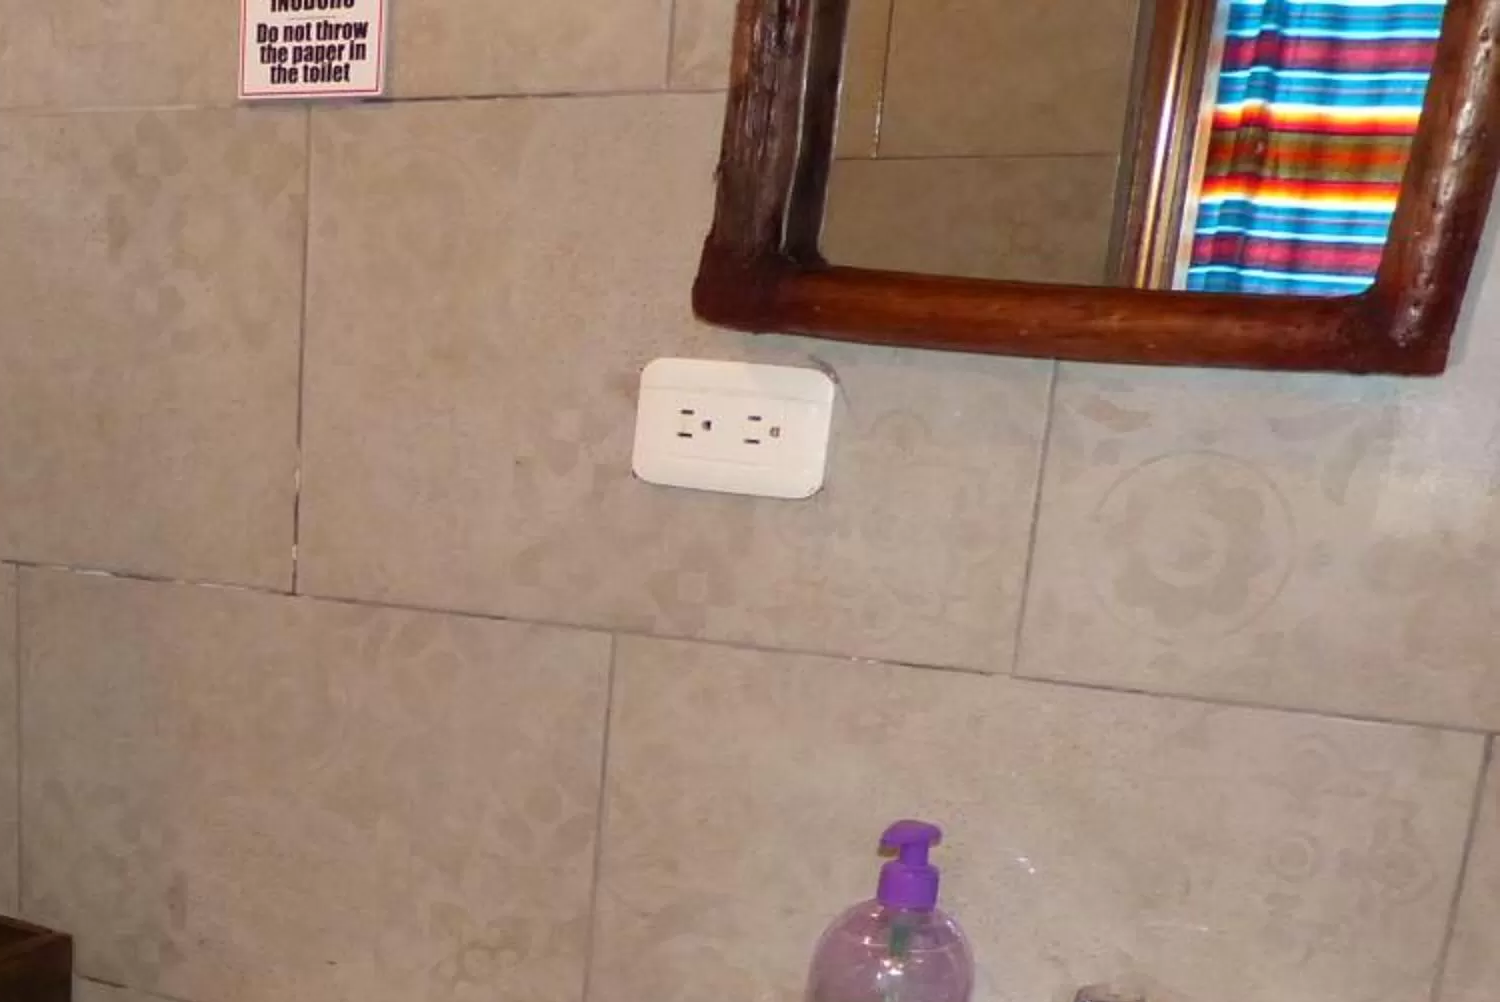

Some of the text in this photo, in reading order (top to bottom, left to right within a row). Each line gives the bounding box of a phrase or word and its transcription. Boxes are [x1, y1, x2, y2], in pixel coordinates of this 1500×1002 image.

[257, 20, 369, 43] Do not throw
[260, 40, 367, 64] the paper in
[270, 62, 350, 84] the toilet
